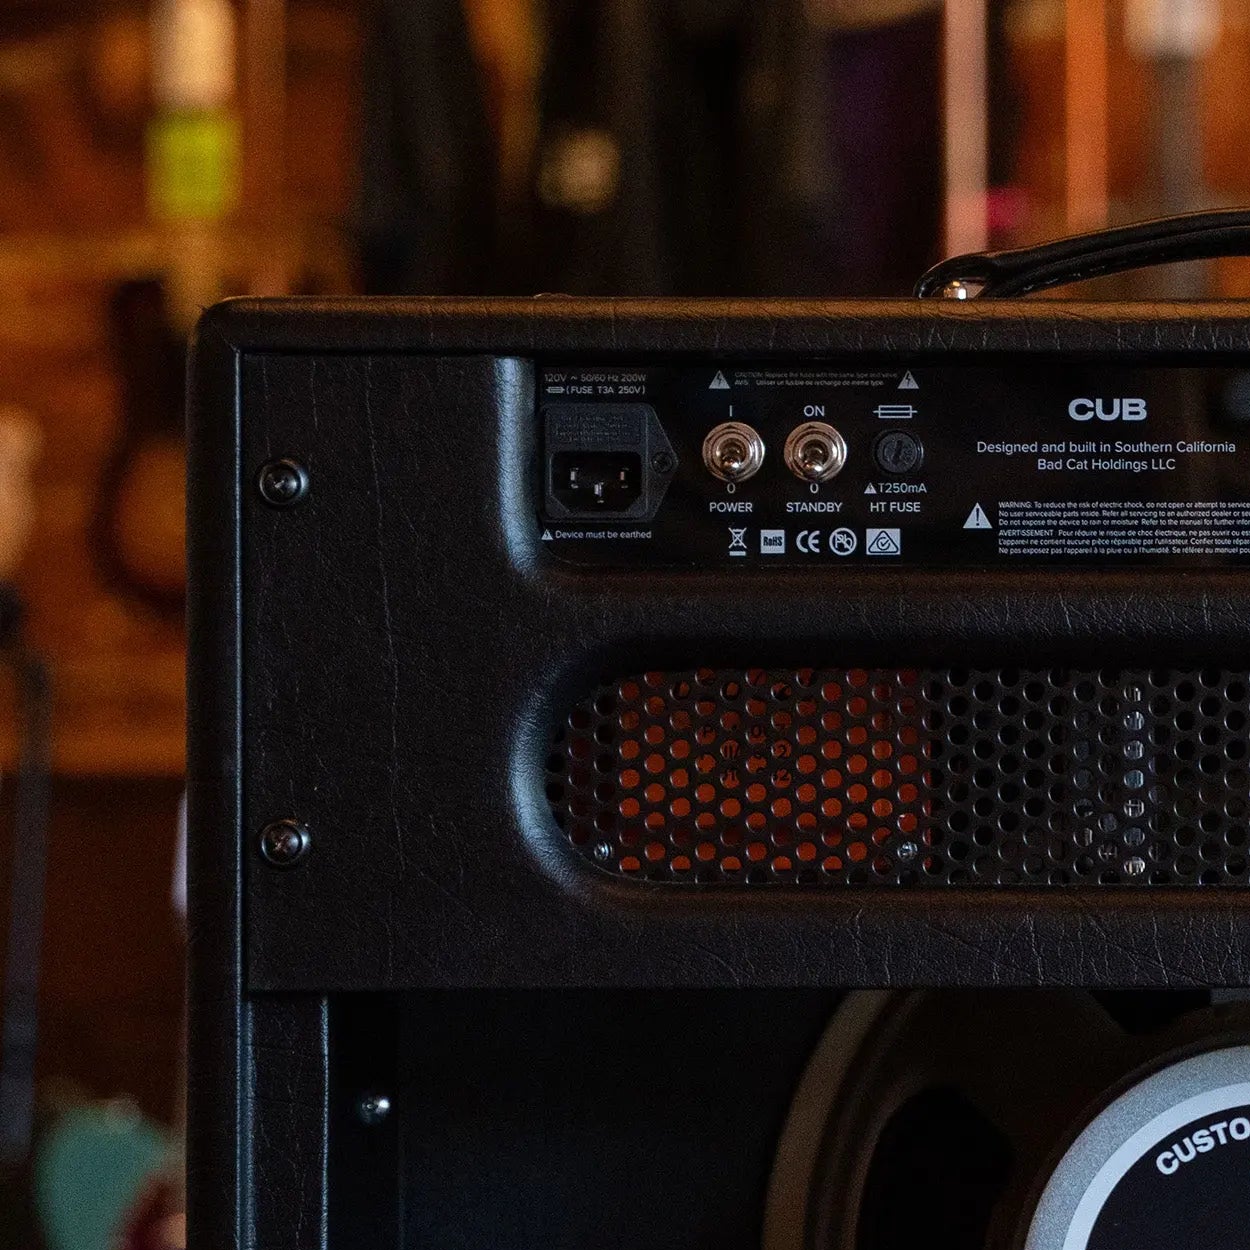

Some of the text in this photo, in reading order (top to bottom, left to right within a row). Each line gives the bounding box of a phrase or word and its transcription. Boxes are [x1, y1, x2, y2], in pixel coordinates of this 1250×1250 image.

[545, 374, 567, 382] 120V
[608, 374, 618, 382] Hz
[620, 374, 646, 382] 200W
[597, 386, 614, 394] T3A
[803, 405, 825, 417] ON
[1068, 397, 1148, 421] CUB
[977, 441, 1236, 455] Designed and built in Southern California
[1037, 459, 1176, 472] Bad Cat Holdings LLC
[878, 483, 927, 494] T250mA
[709, 502, 753, 513] POWER
[786, 502, 843, 513] STANDBY
[870, 502, 921, 513] HT FUSE
[555, 530, 652, 539] Device must be earthed
[796, 530, 820, 553] CE
